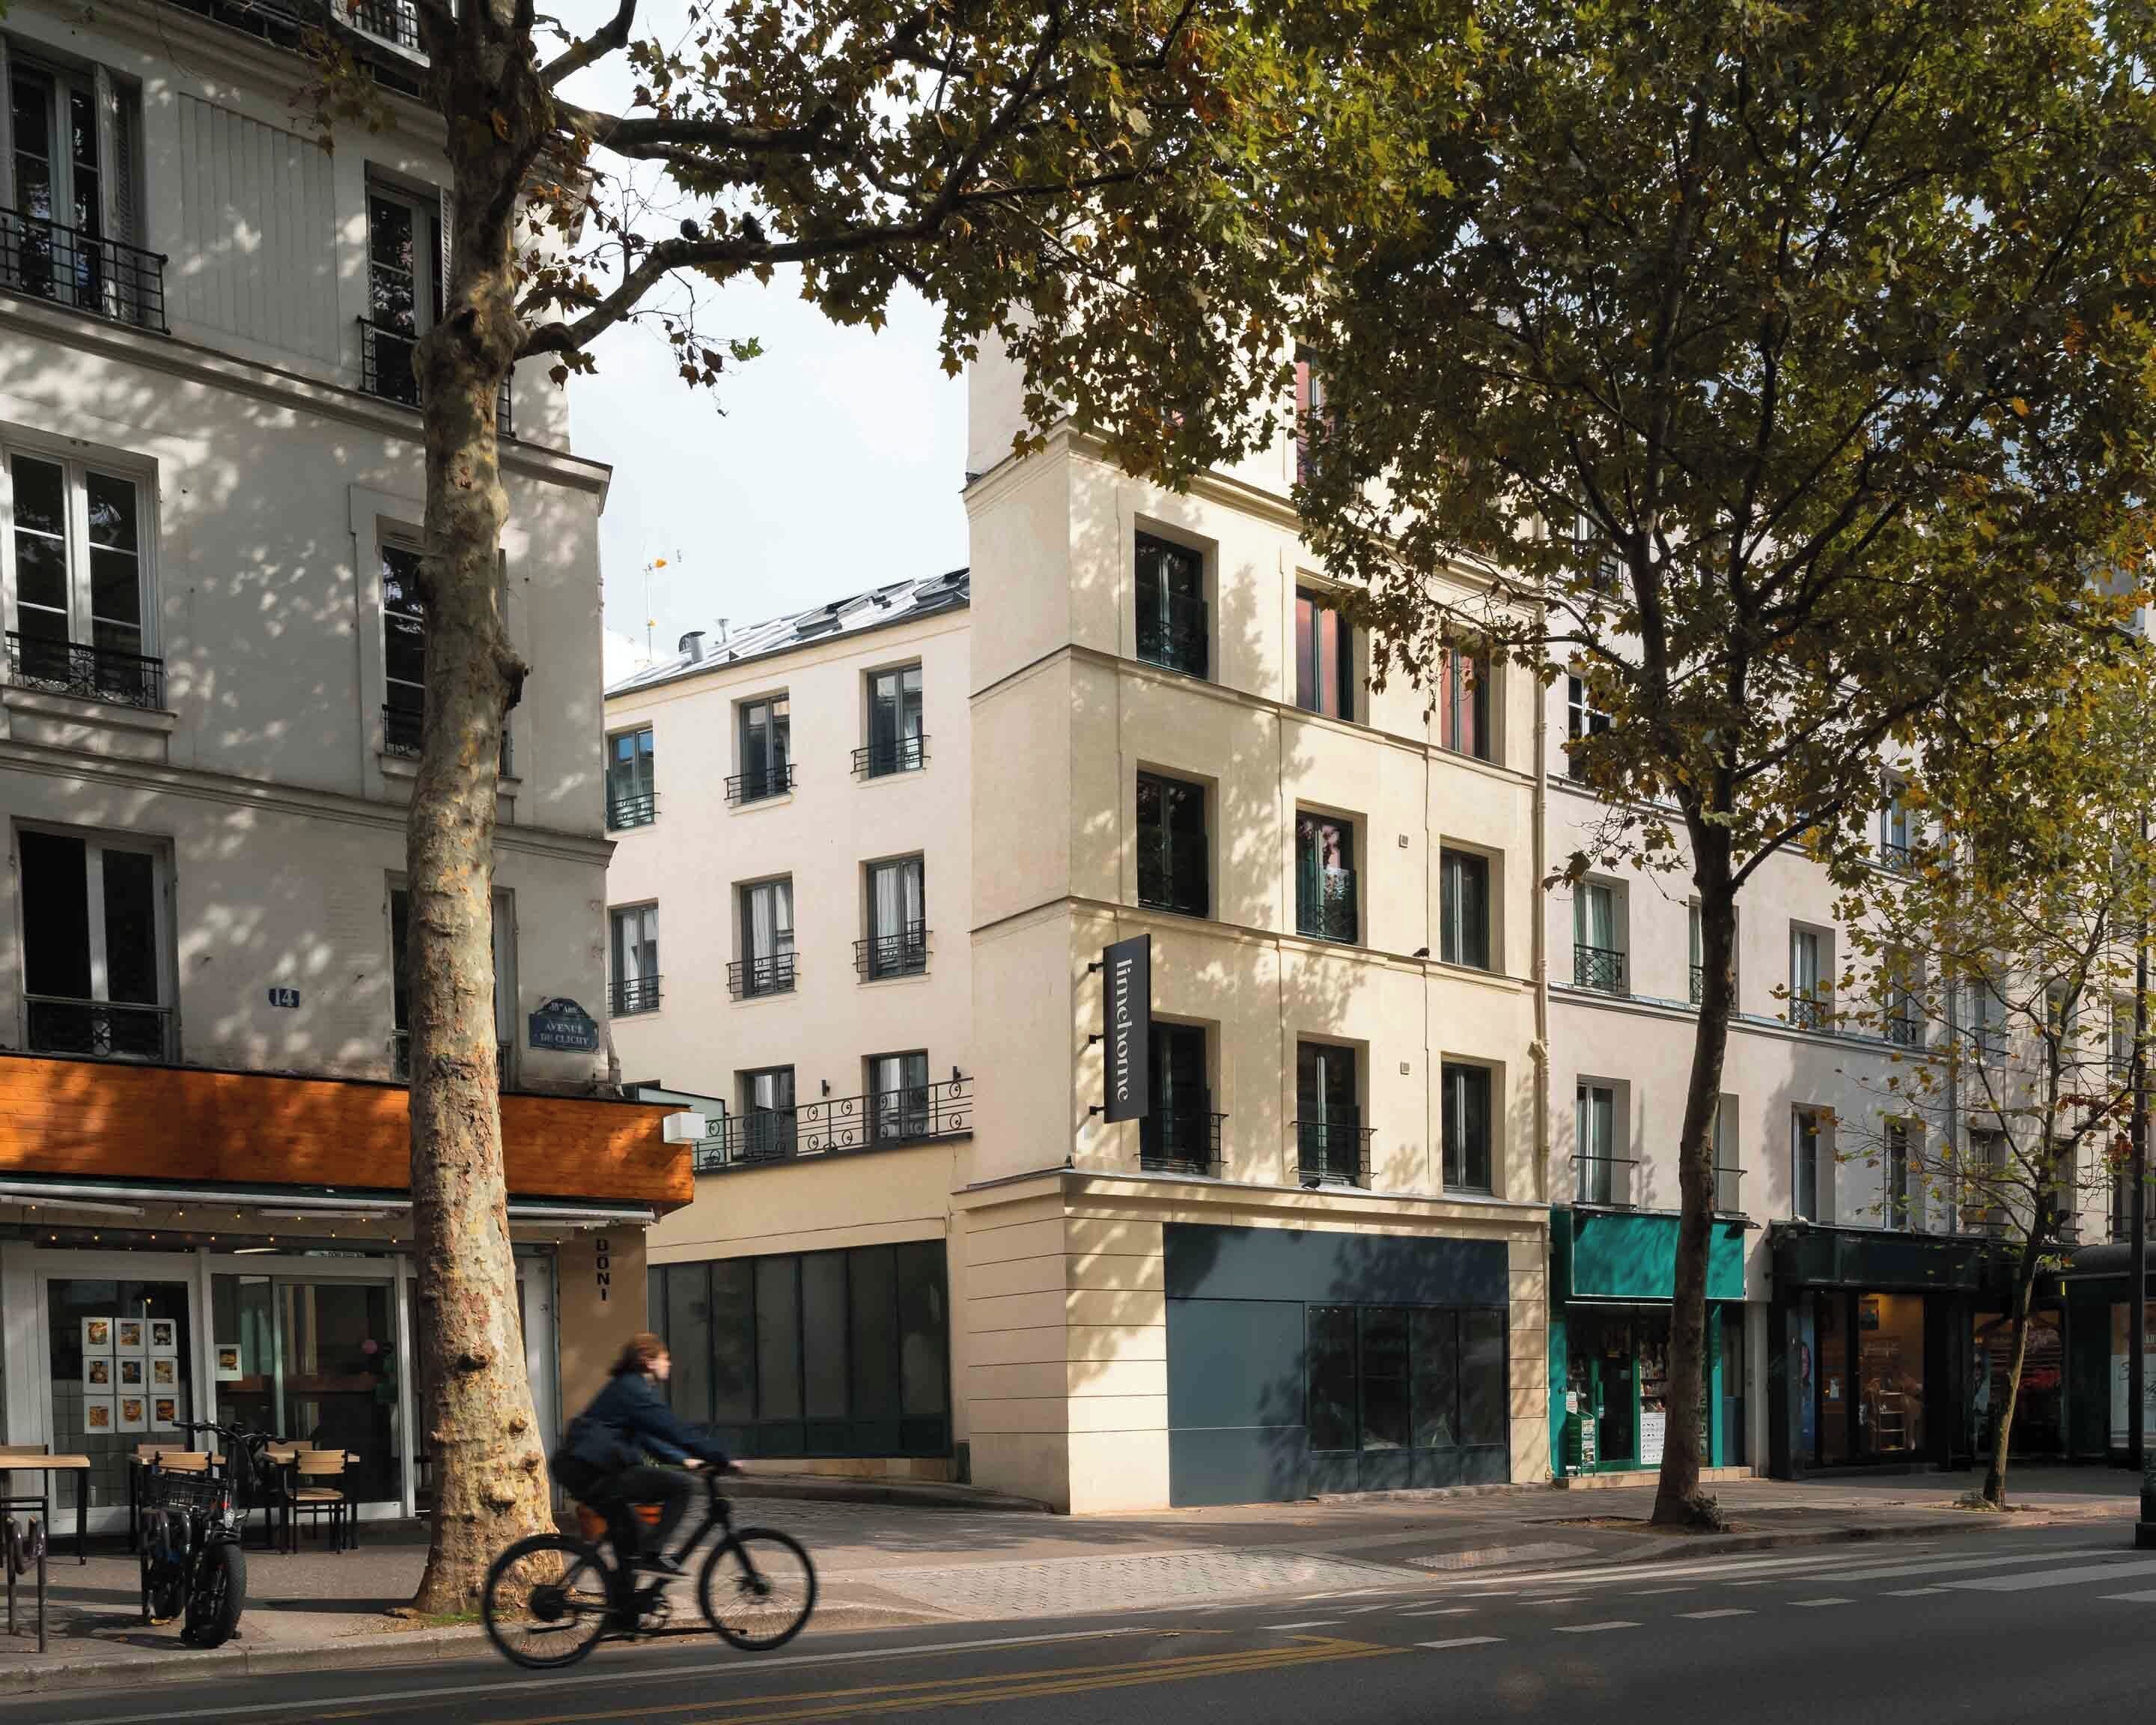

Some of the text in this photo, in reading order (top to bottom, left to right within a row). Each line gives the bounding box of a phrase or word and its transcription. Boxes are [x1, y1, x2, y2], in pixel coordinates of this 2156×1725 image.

[275, 988, 294, 1007] 14
[545, 1023, 583, 1034] AVENUE
[1116, 958, 1133, 1102] limehome
[539, 1032, 588, 1045] DE CLICHY
